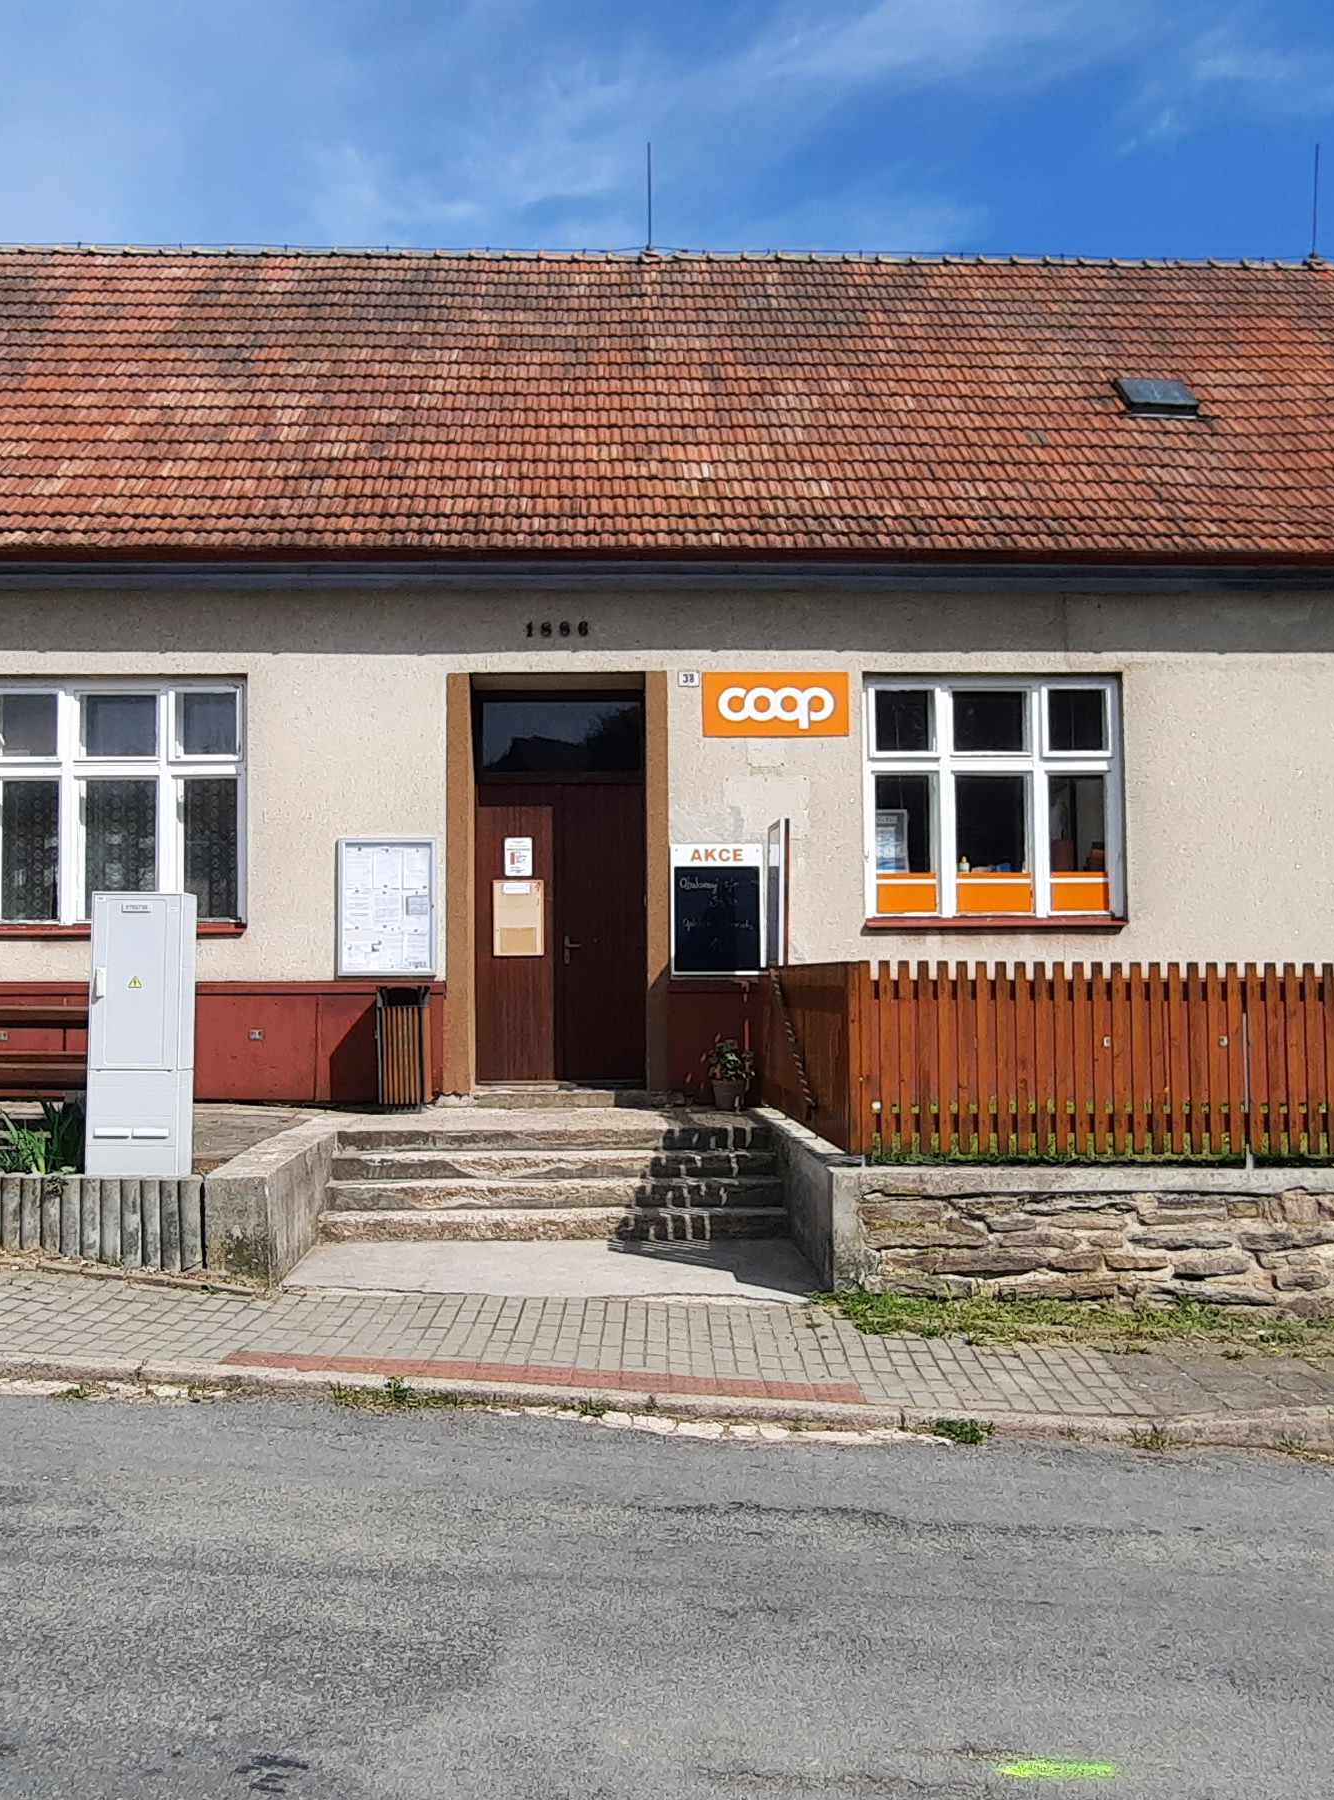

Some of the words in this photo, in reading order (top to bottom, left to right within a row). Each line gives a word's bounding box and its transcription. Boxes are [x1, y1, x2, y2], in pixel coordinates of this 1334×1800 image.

[526, 621, 588, 637] 1886
[718, 686, 835, 730] coop
[690, 848, 744, 862] AKCE
